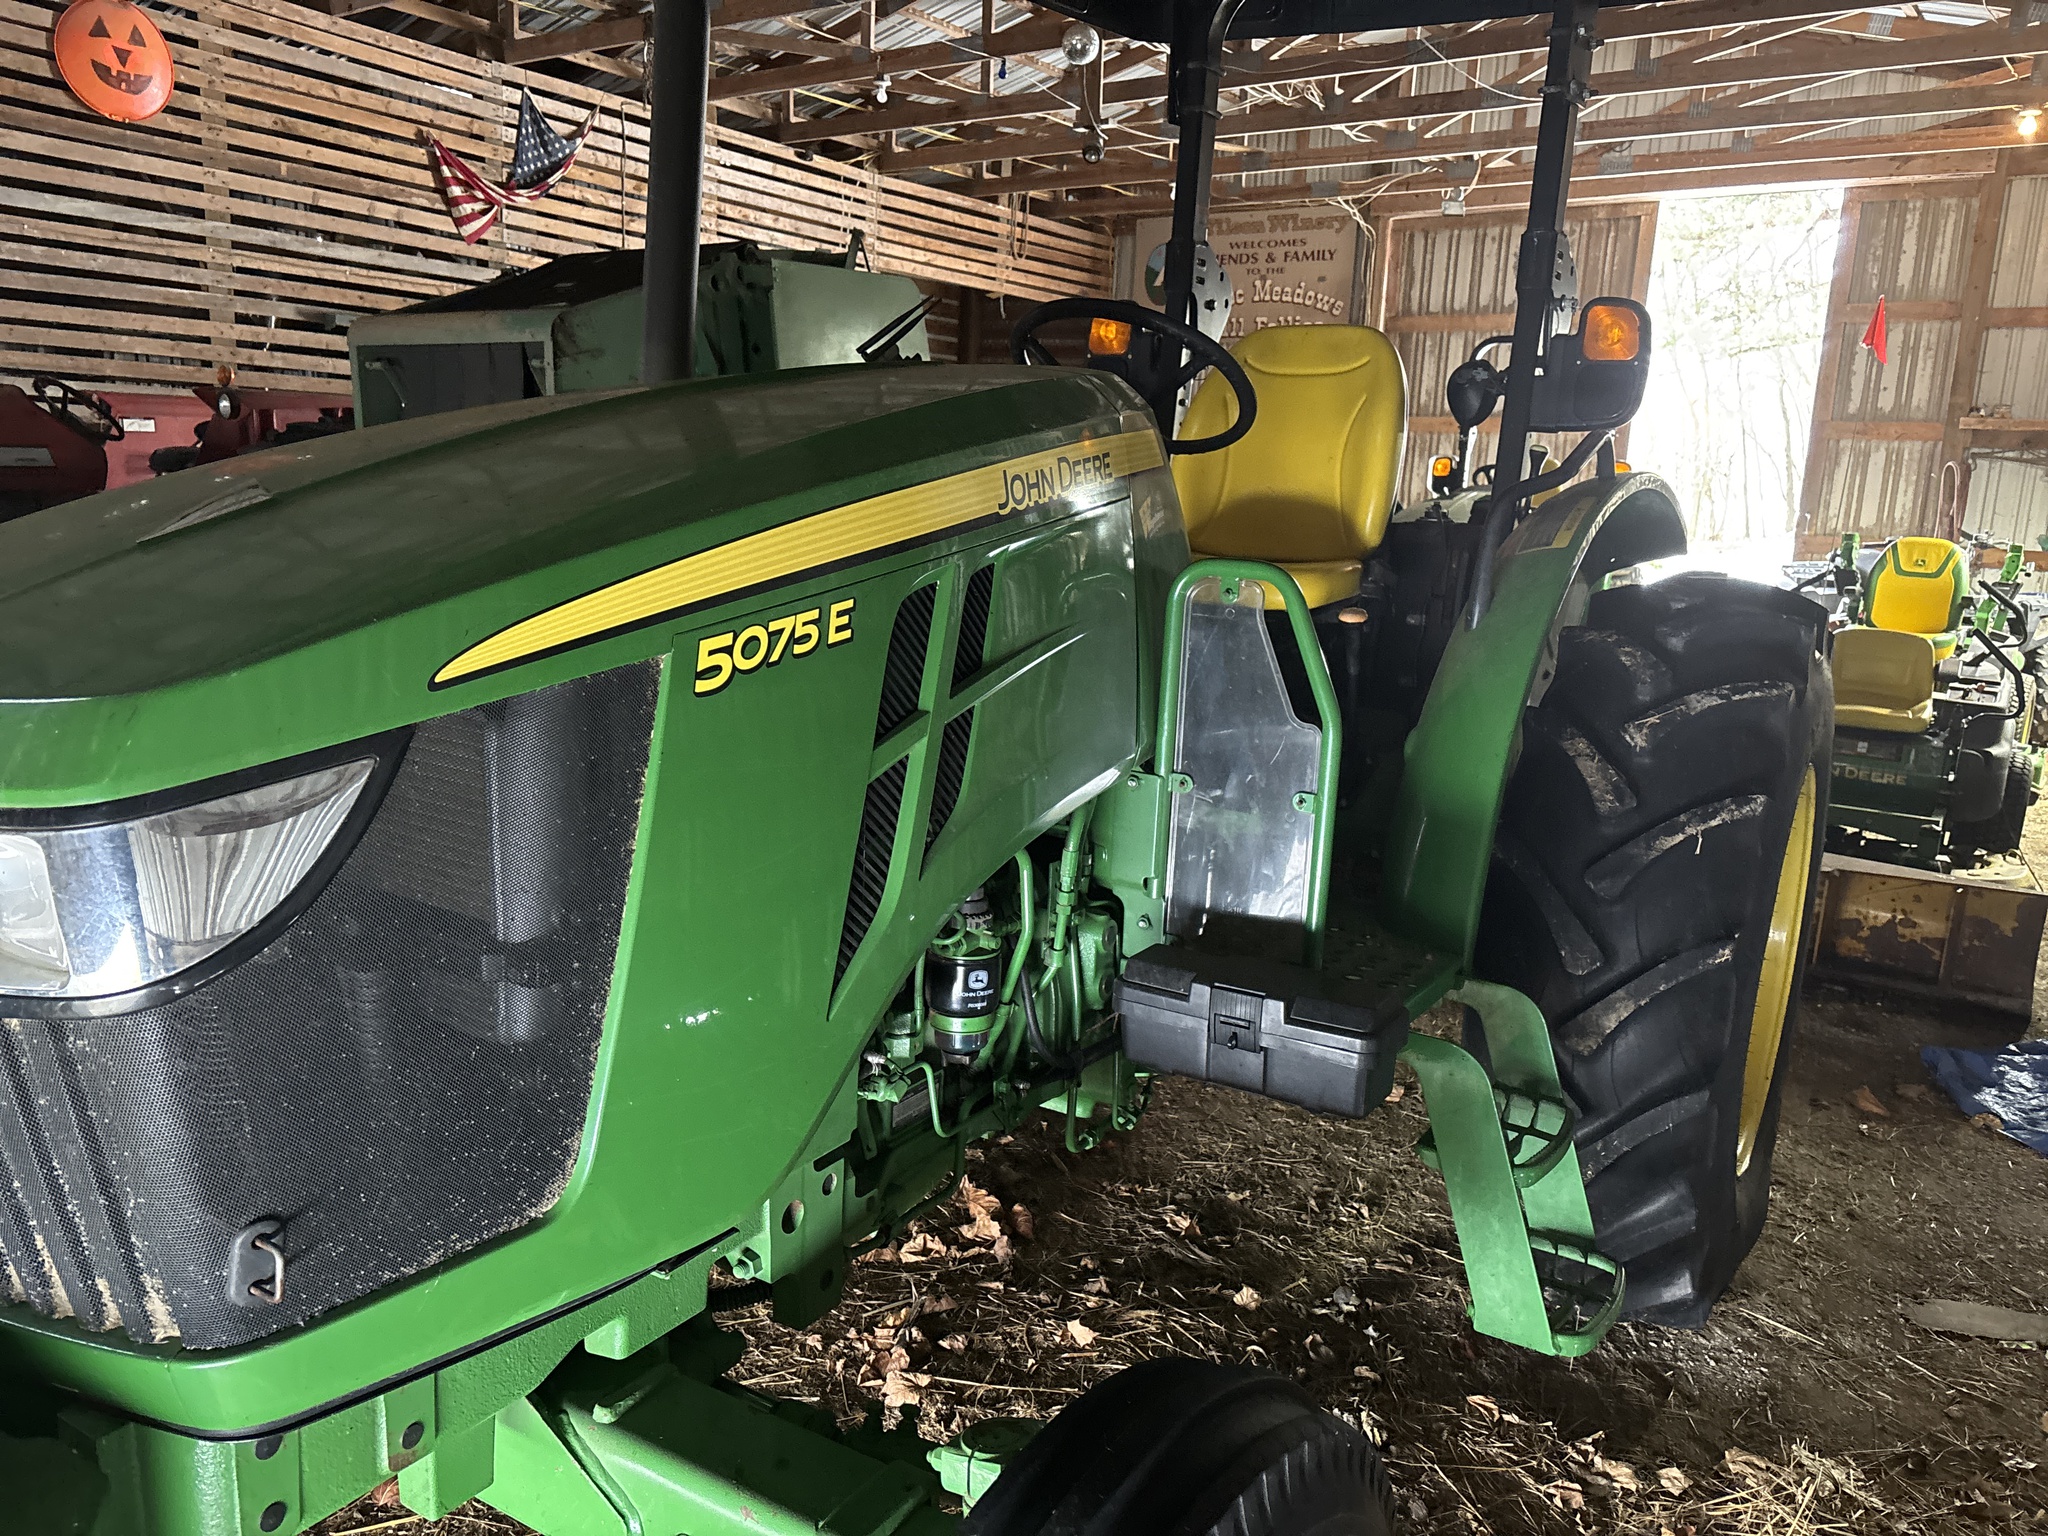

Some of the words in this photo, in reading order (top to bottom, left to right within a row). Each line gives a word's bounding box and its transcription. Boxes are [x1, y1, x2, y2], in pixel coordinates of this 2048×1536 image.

[1229, 238, 1308, 250] WELCOMES
[1215, 252, 1259, 266] ENDS
[1265, 251, 1277, 264] &
[1283, 249, 1338, 263] FAMILY
[1246, 267, 1261, 275] TO
[1266, 267, 1286, 275] THE
[1252, 279, 1344, 316] Meadows
[998, 468, 1056, 512] JOHN
[1057, 451, 1114, 494] DEERE
[1845, 766, 1907, 785] DEERE
